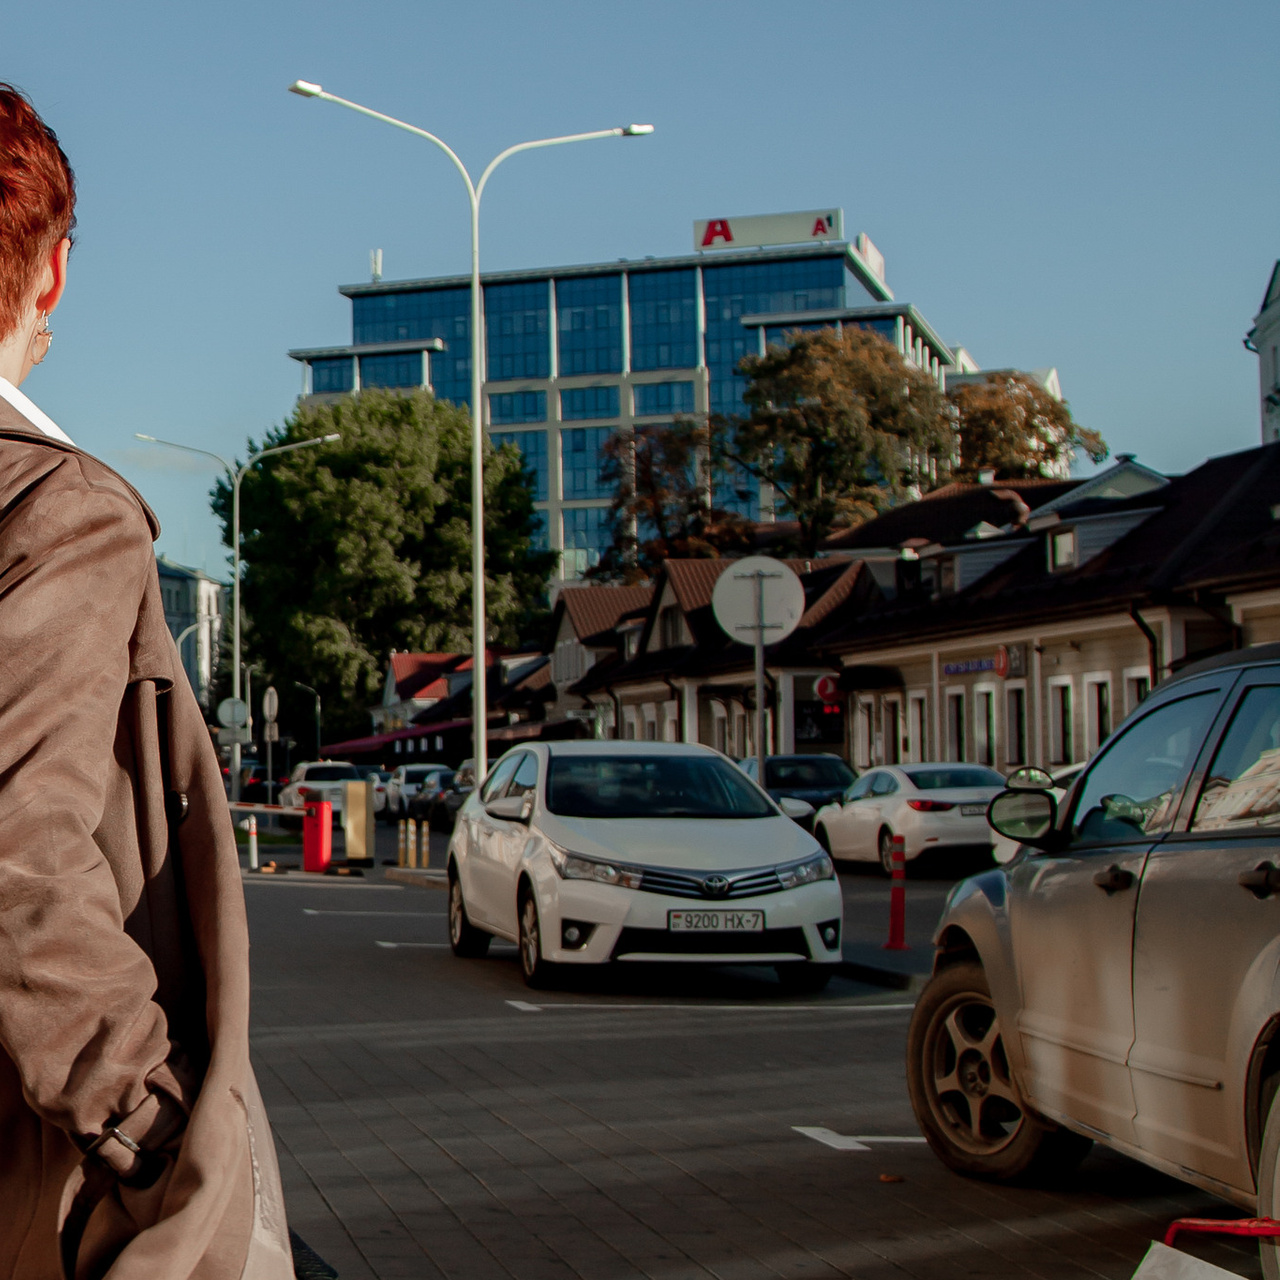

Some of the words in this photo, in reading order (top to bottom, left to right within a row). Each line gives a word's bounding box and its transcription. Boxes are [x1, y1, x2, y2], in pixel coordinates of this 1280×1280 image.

[702, 219, 734, 247] A
[685, 914, 719, 929] 9200
[724, 914, 760, 929] HX-7
